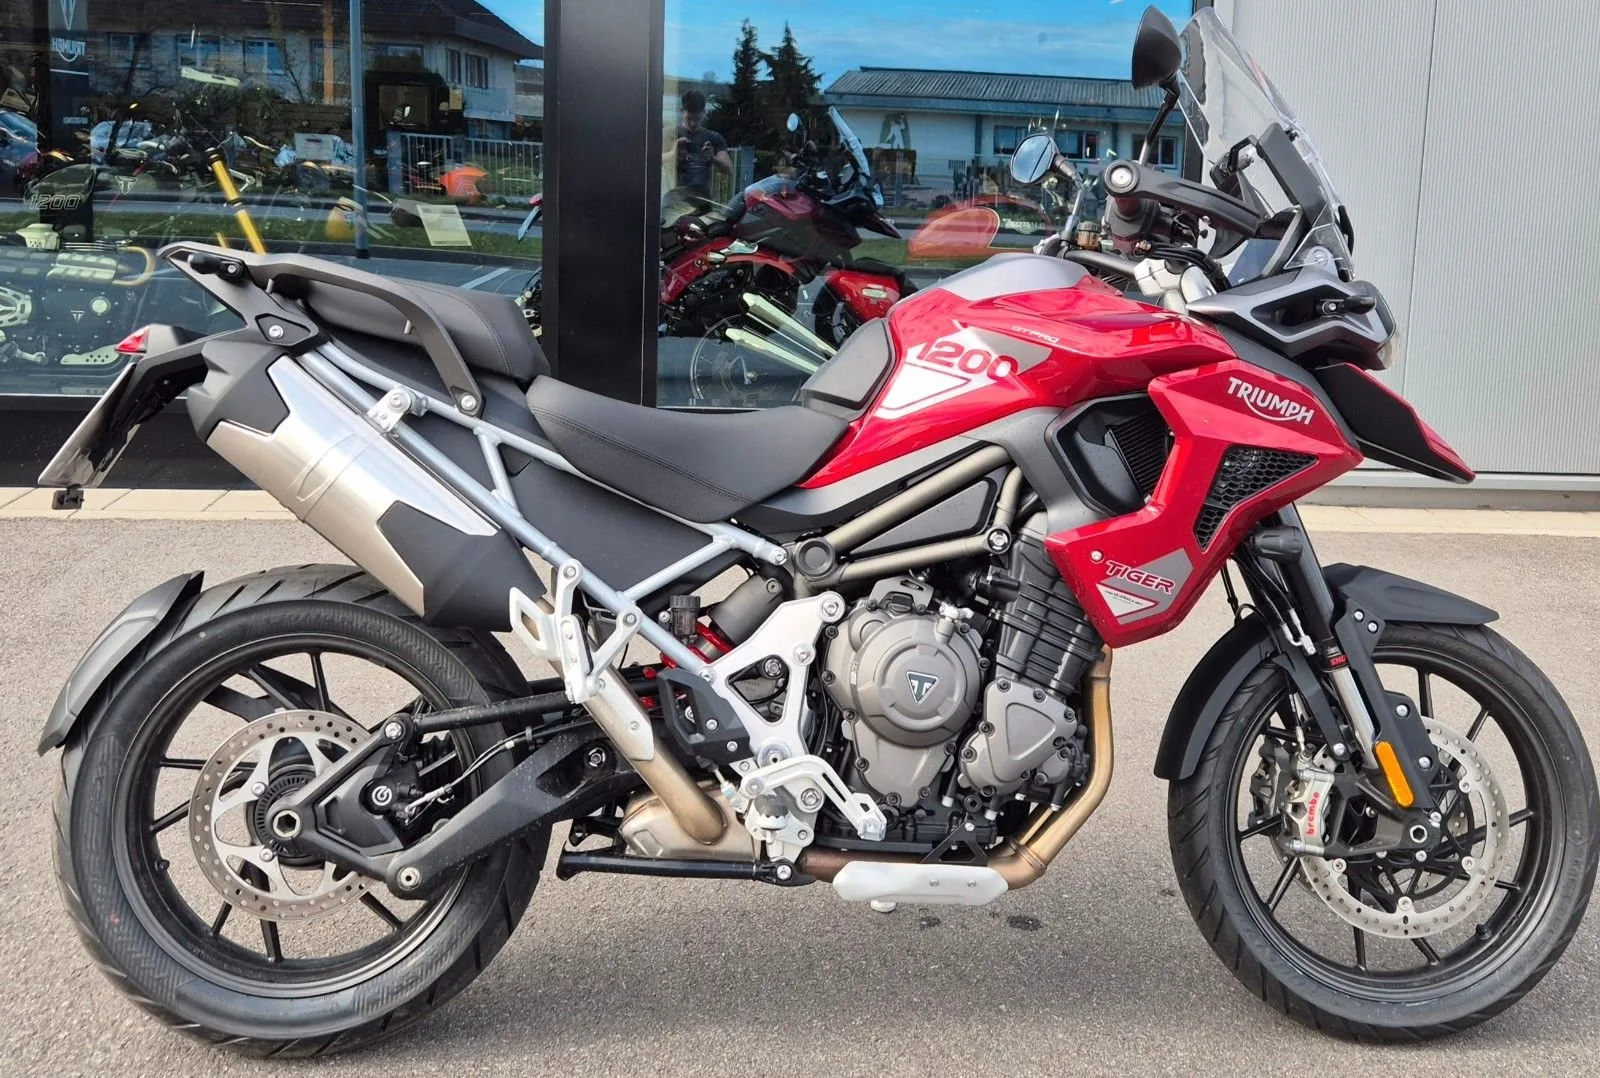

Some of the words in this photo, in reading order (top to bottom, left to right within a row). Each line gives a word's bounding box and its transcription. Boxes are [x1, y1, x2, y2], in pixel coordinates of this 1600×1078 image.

[29, 194, 81, 210] 1200
[916, 340, 1019, 382] 1200
[1227, 376, 1315, 425] TRIUMPH
[1105, 560, 1175, 595] TIGER
[1306, 791, 1320, 836] brembo
